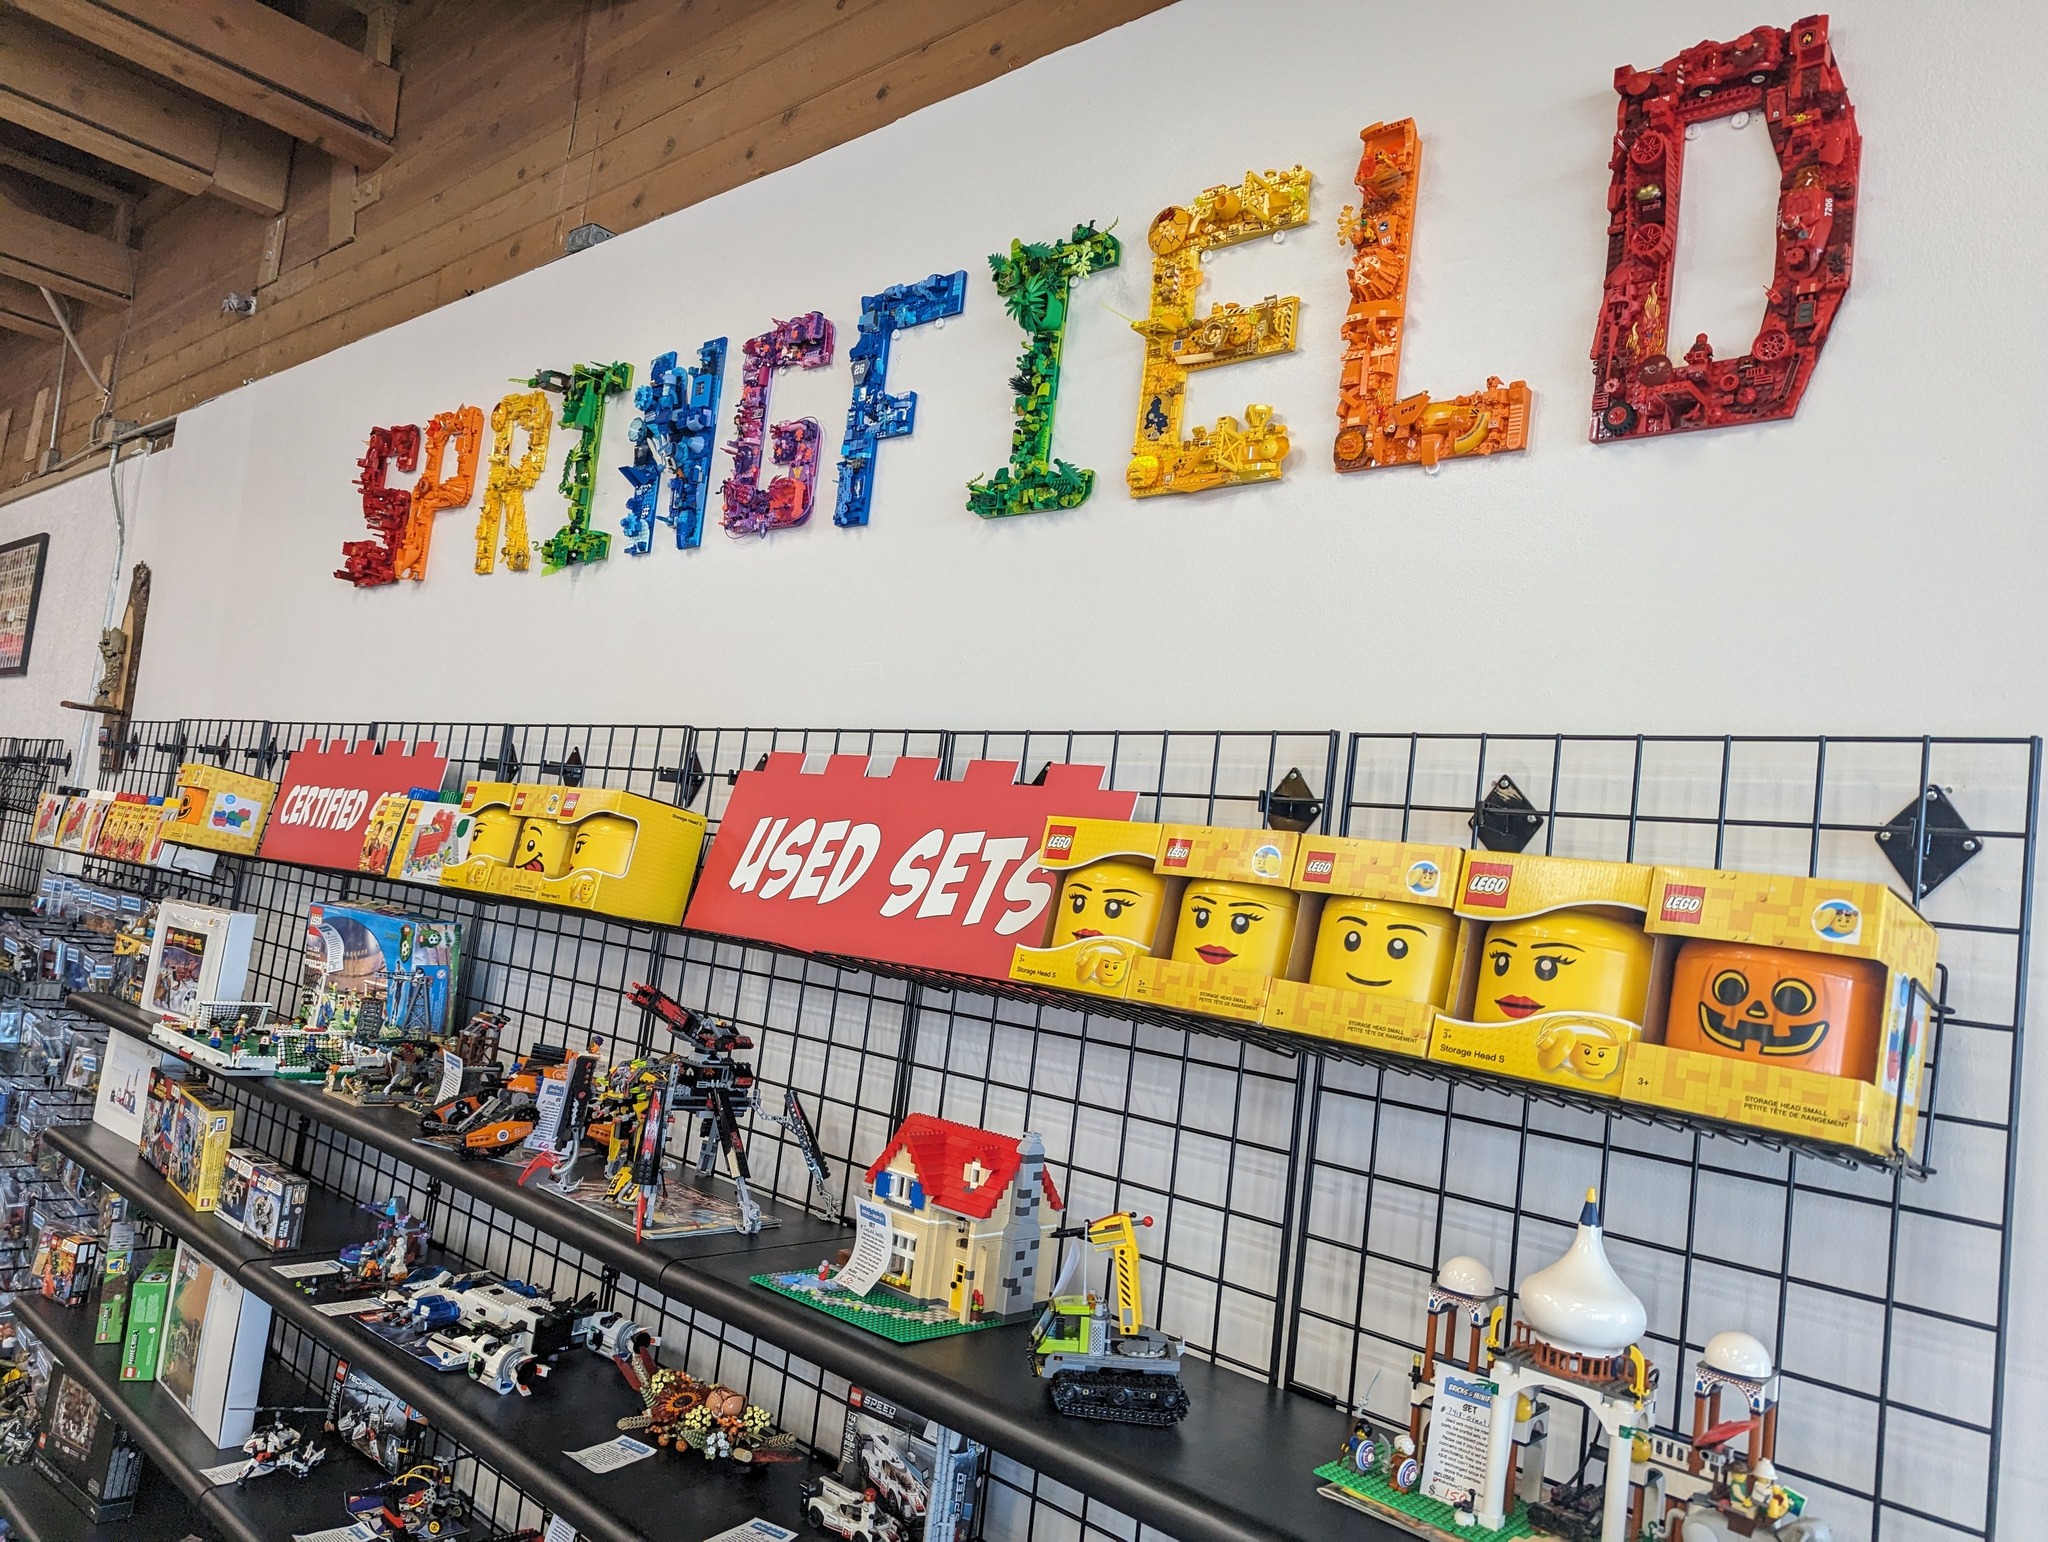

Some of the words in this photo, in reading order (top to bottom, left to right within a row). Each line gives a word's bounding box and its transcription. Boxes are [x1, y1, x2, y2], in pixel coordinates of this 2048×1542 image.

[1824, 197, 1833, 216] 7206
[1381, 235, 1392, 246] 02
[333, 14, 1862, 587] SPRINGFIELD
[854, 364, 865, 375] 26
[280, 784, 368, 832] CERTIFIED
[672, 814, 687, 822] Storage
[1047, 834, 1072, 850] LEGO
[1166, 844, 1189, 859] LEGO
[1306, 859, 1333, 875] LEGO
[728, 816, 882, 905] USED
[879, 828, 1052, 936] SETS
[1468, 874, 1510, 895] LEGO
[1664, 895, 1703, 912] LEGO
[1017, 966, 1036, 976] Storage
[1231, 1002, 1258, 1011] RANGEMENT
[1233, 996, 1246, 1004] SMALL
[1348, 1020, 1372, 1029] STORAGE
[1387, 1027, 1404, 1035] SMALL
[1385, 1034, 1418, 1043] RANGEMENT
[1440, 1044, 1472, 1058] Storage
[1474, 1050, 1496, 1062] Head
[1499, 1055, 1505, 1063] S
[1637, 1077, 1649, 1086] 3+
[1745, 1095, 1778, 1107] STORAGE
[1780, 1103, 1801, 1111] HEAD
[1803, 1106, 1828, 1116] SMALL
[1744, 1103, 1767, 1112] PETITE
[1770, 1107, 1786, 1116] TÊTE
[1801, 1114, 1848, 1128] RANGEMENT
[128, 1329, 138, 1365] MINECRAFT
[348, 1373, 374, 1392] TECHNIC
[851, 1391, 861, 1401] LEGO
[1448, 1383, 1469, 1395] BRICKS
[1473, 1393, 1492, 1403] MINIF
[863, 1395, 896, 1416] SPEED
[1463, 1404, 1478, 1414] SET
[954, 1472, 964, 1522] SPEED
[1428, 1484, 1435, 1495] $
[1445, 1488, 1467, 1503] 150
